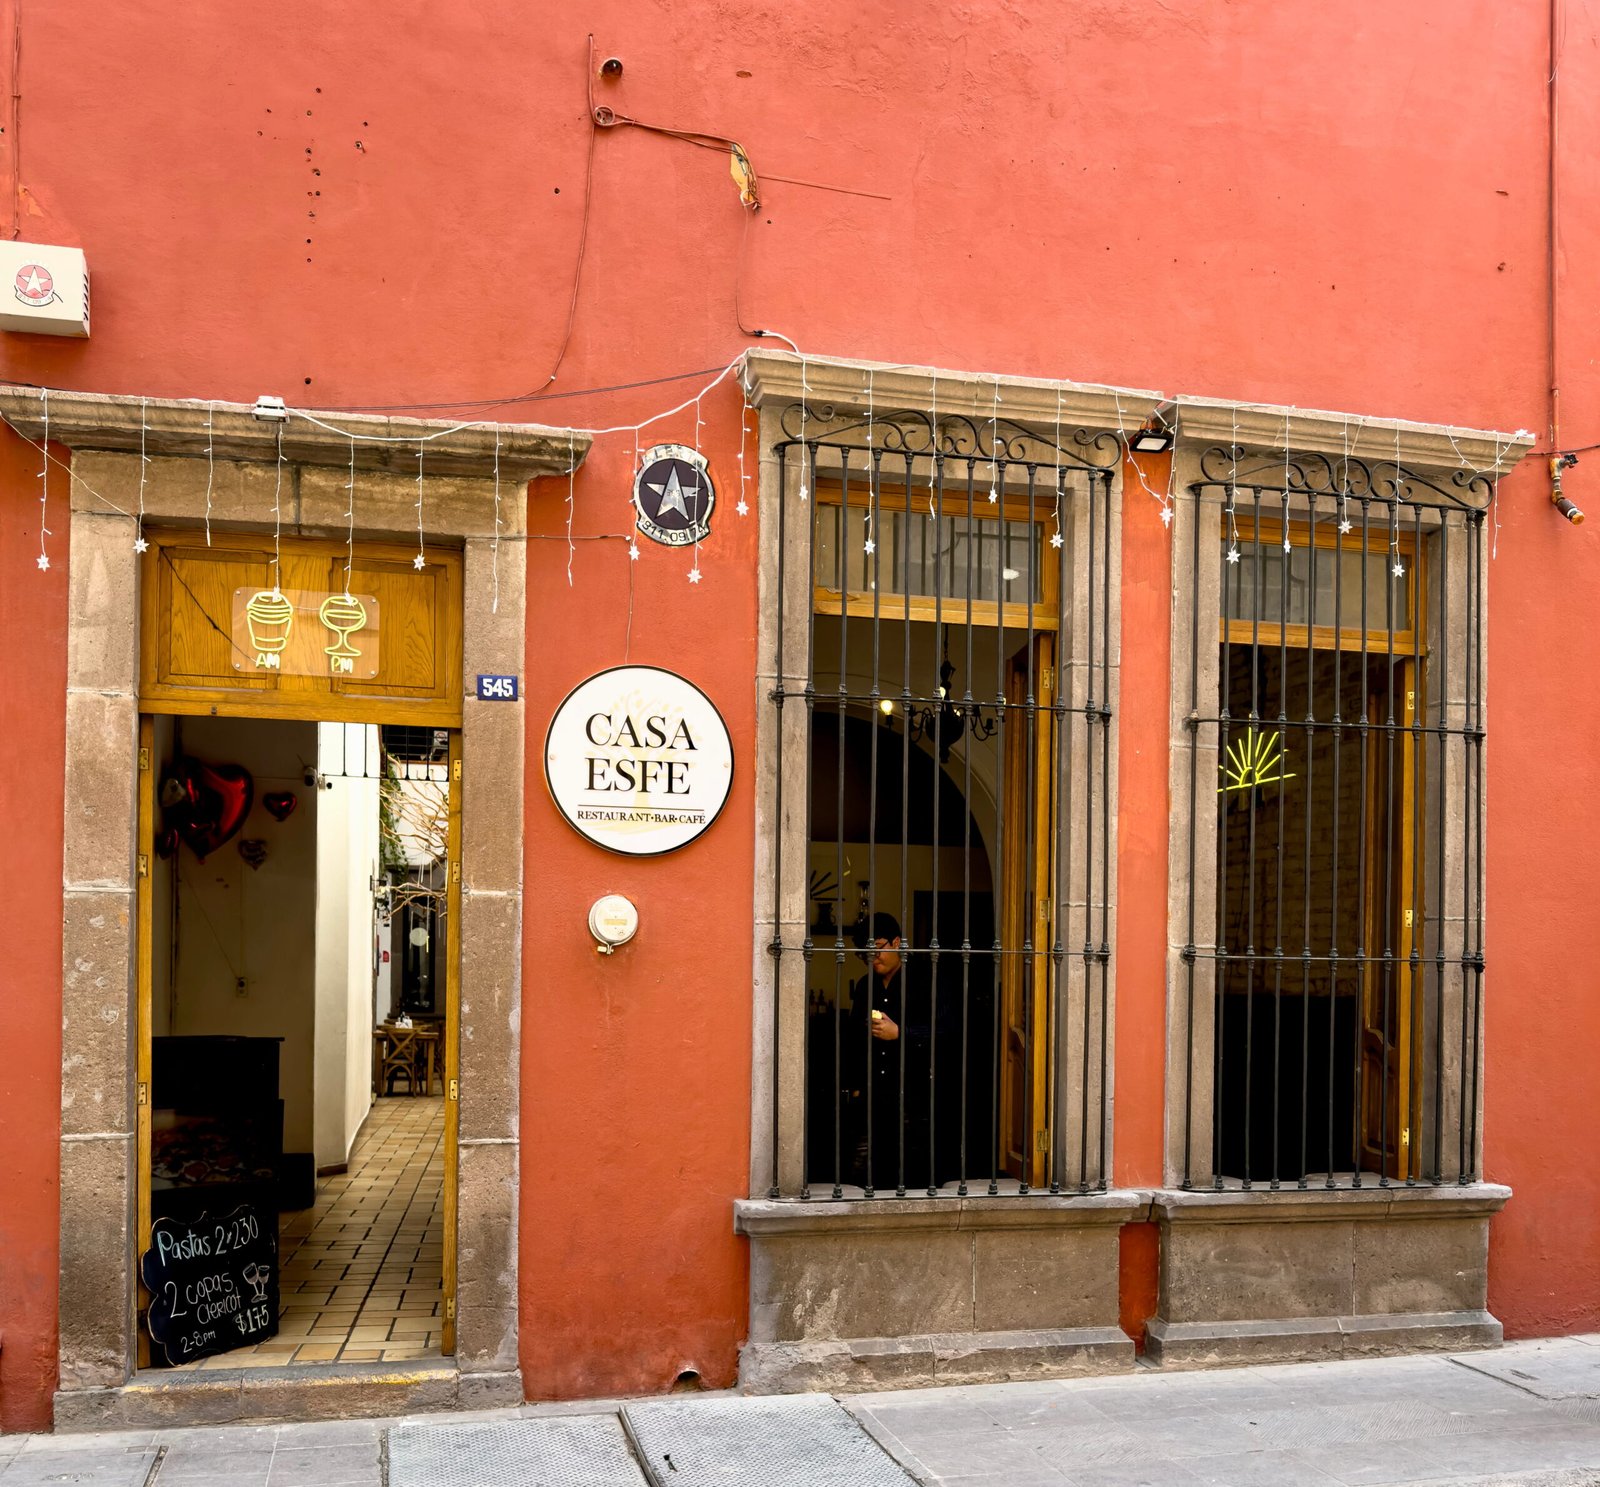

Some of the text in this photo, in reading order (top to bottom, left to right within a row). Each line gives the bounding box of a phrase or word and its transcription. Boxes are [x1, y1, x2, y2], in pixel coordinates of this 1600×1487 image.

[256, 653, 280, 669] AM
[331, 656, 353, 673] PM
[482, 678, 514, 697] 545
[585, 713, 698, 750] CASA
[584, 757, 691, 795] ESFE
[157, 1229, 211, 1267] Pastas
[164, 1281, 187, 1318] 2
[234, 1304, 269, 1335] $175
